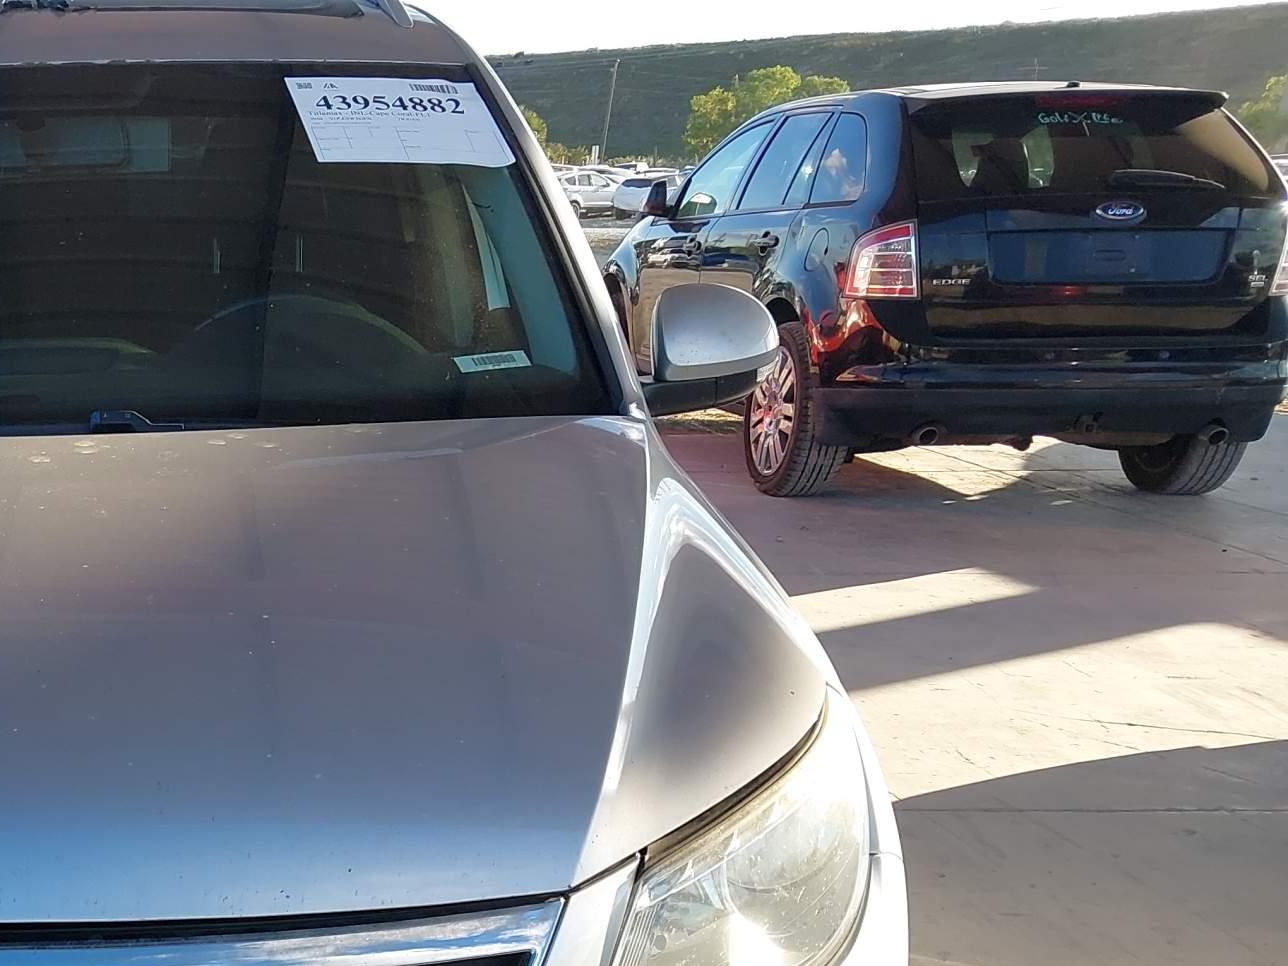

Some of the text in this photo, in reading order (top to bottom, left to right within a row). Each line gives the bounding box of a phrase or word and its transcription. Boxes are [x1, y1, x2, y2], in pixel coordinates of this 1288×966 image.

[315, 94, 465, 115] 43954882
[1107, 205, 1134, 216] Ford
[932, 278, 972, 287] EDGE
